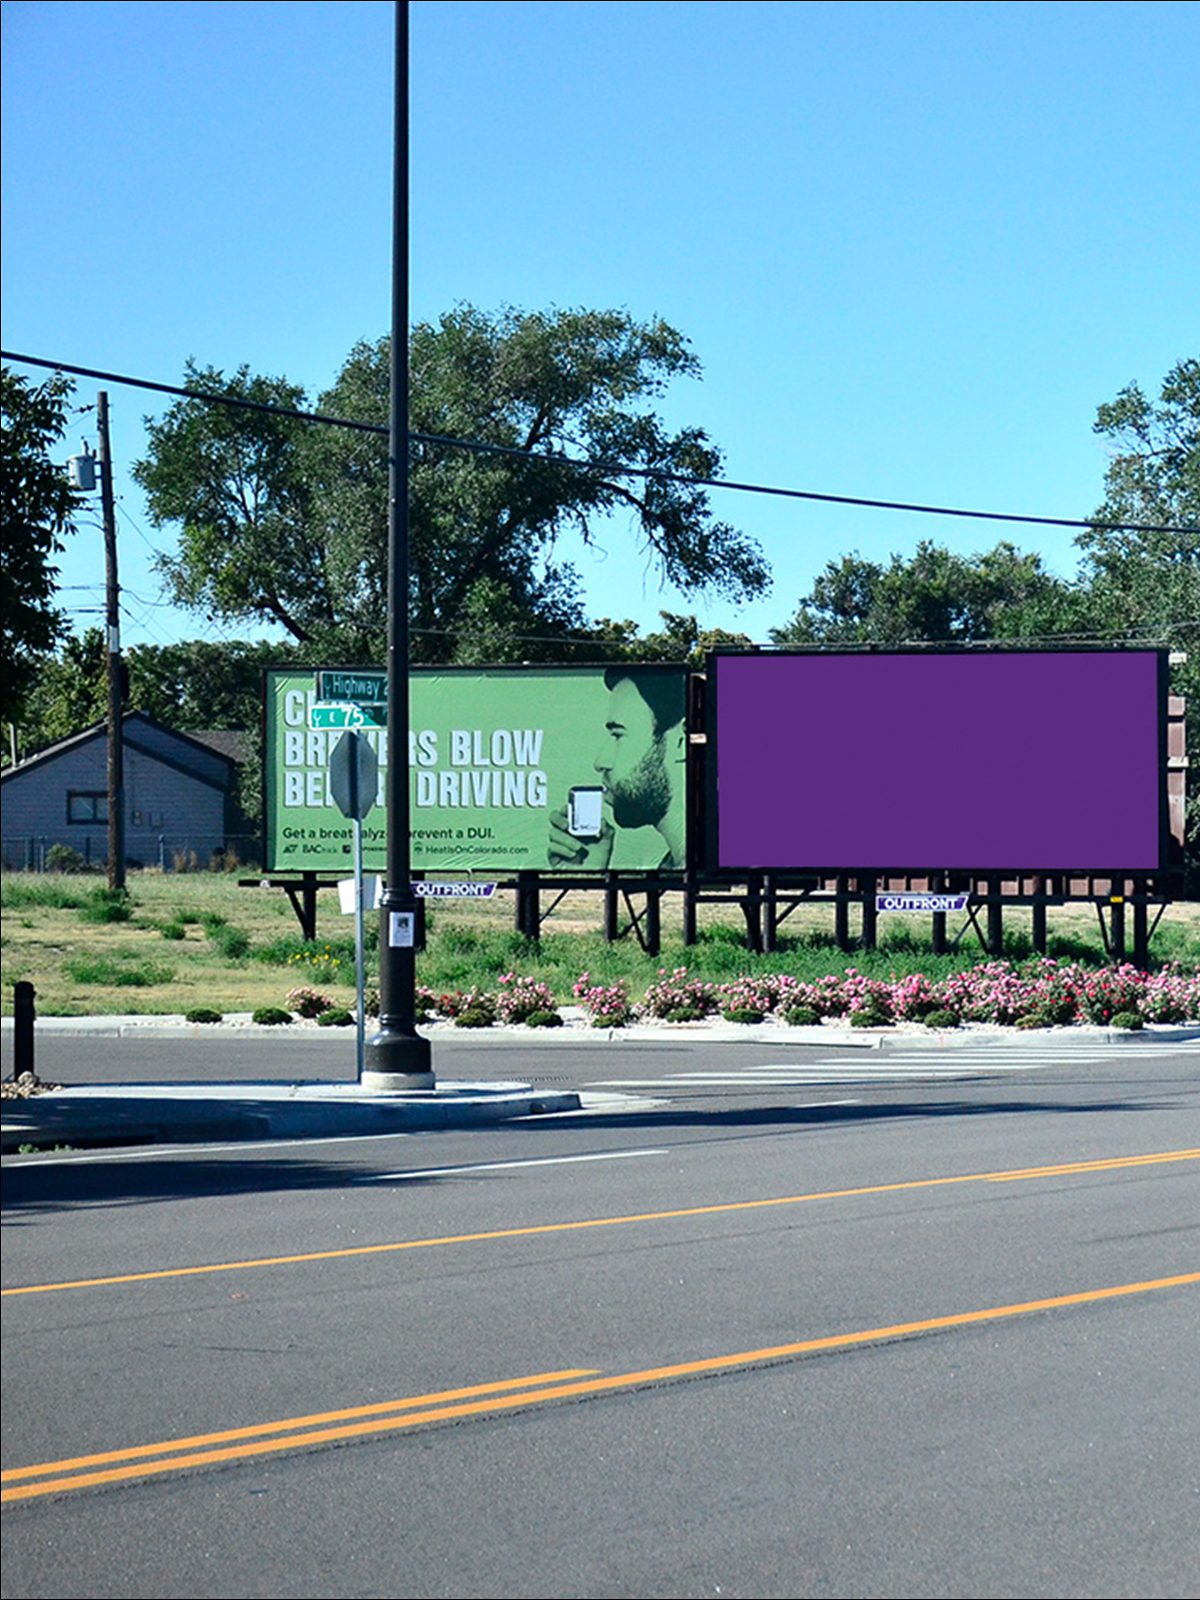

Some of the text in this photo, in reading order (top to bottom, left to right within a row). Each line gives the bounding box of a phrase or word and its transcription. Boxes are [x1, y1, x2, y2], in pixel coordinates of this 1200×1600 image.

[332, 676, 380, 700] Highway
[451, 730, 544, 766] BLOW
[417, 770, 548, 807] DRIVING
[282, 827, 305, 839] Get
[308, 829, 316, 839] a
[409, 828, 453, 839] revent
[456, 829, 463, 839] a
[467, 828, 495, 839] DUI.
[416, 883, 487, 896] OUTFRONT
[884, 897, 958, 910] OUTFRONT
